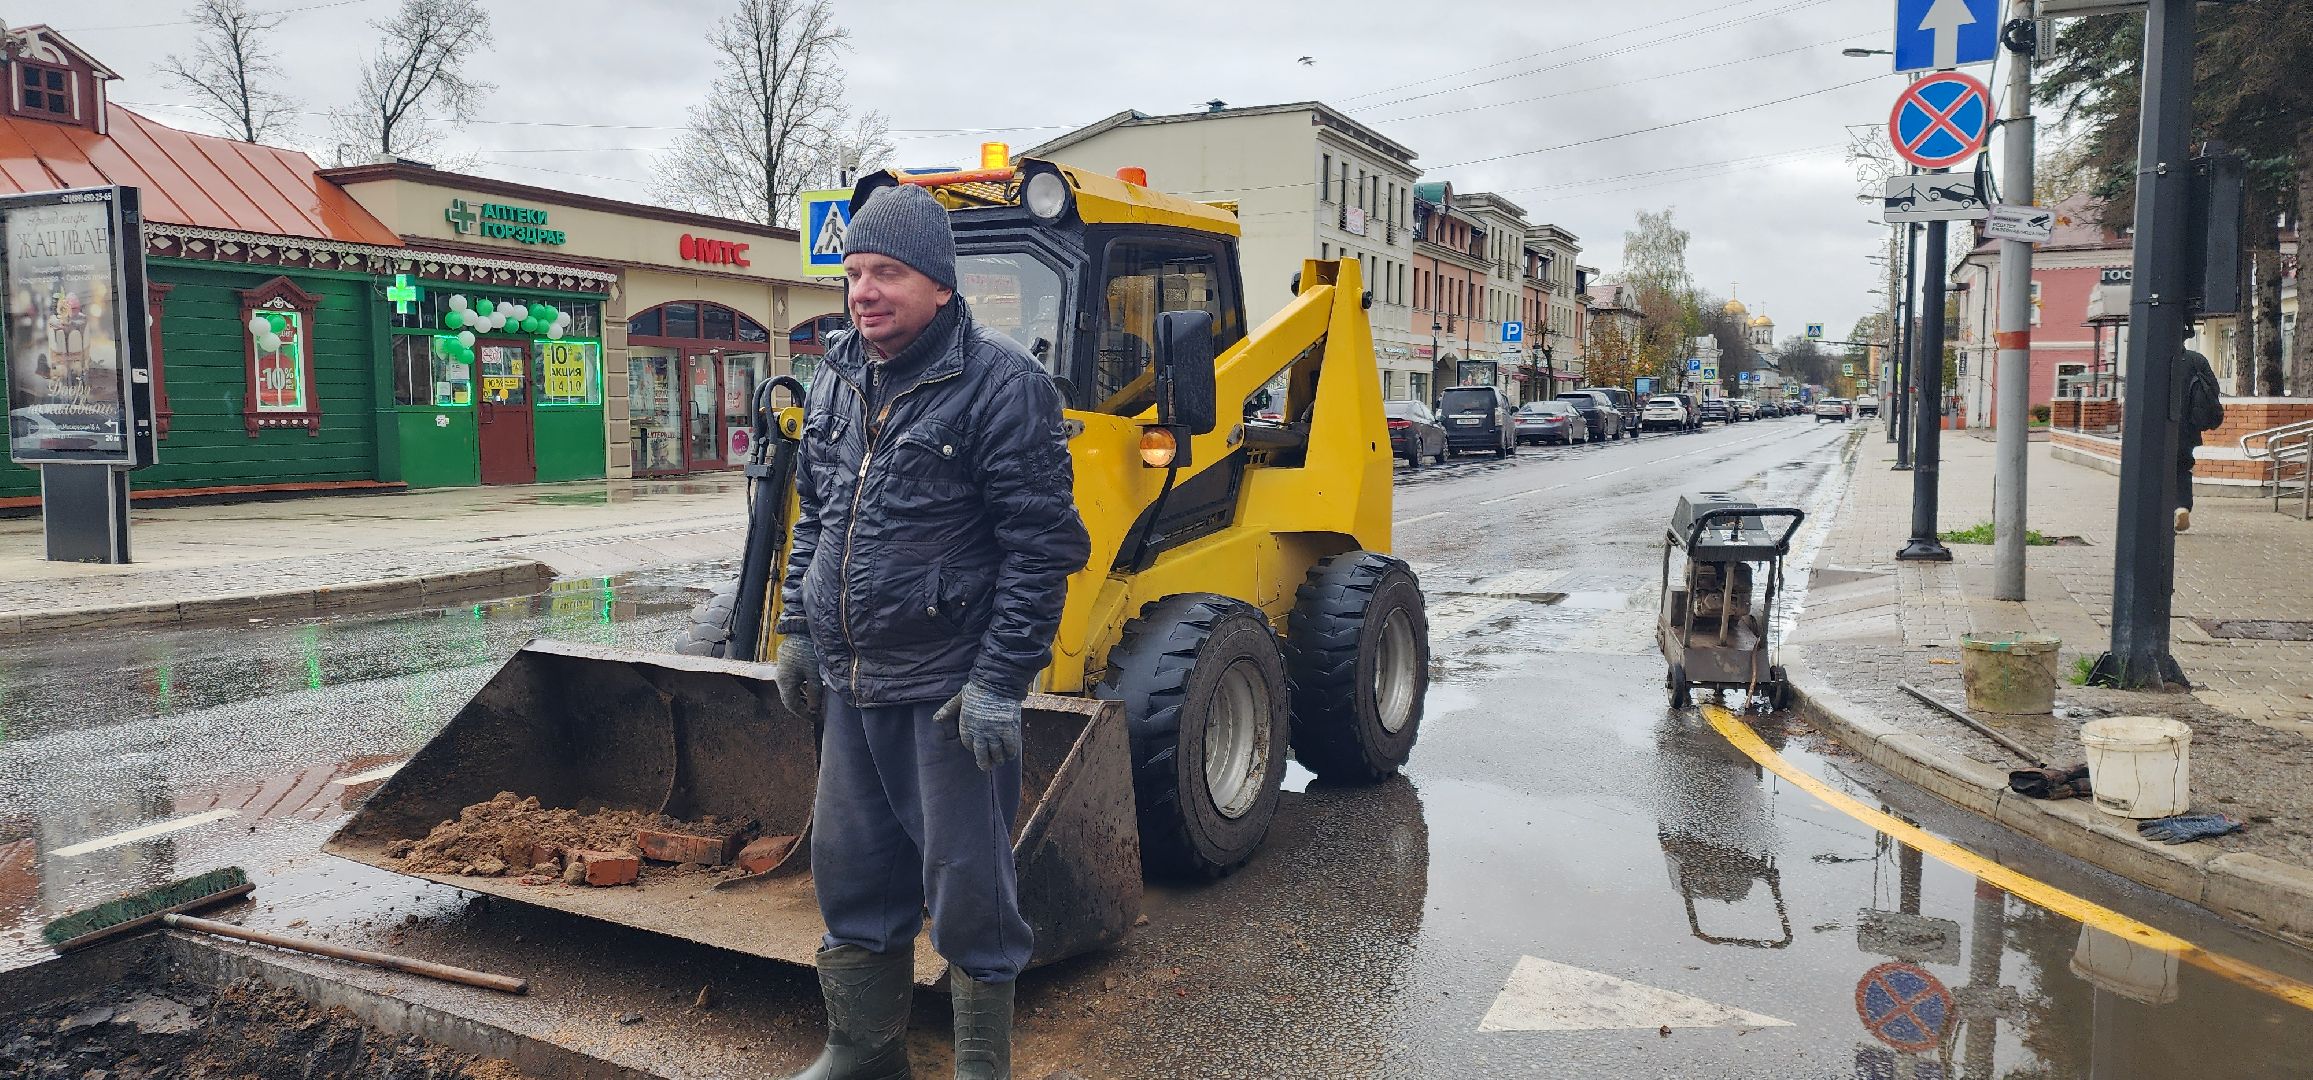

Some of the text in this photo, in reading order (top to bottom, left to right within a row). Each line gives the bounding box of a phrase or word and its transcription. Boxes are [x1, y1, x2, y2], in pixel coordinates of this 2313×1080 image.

[481, 202, 548, 226] АПТЕКИ
[16, 227, 110, 259] ЖАН ИВАН
[480, 221, 567, 246] ГОРЗДРАВ
[695, 237, 751, 267] МТС
[550, 367, 582, 377] АКЦИЯ
